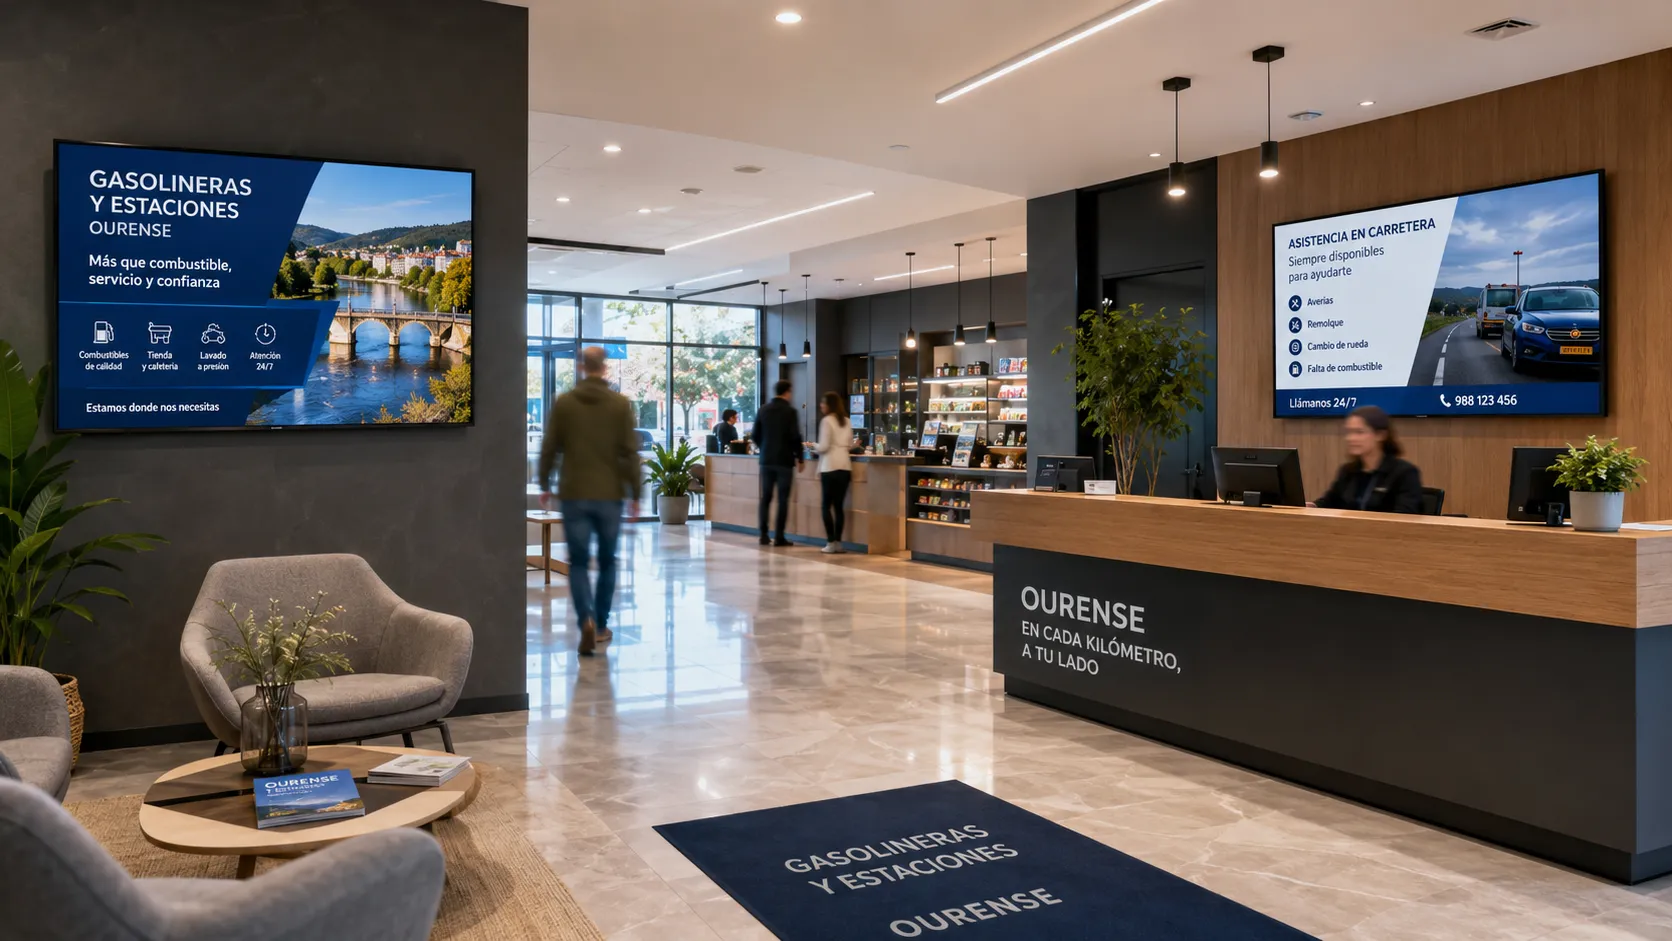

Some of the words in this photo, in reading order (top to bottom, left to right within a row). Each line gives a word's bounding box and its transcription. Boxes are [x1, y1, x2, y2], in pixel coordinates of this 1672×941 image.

[89, 169, 252, 196] GASOLINERAS
[89, 195, 105, 213] Y
[111, 196, 239, 219] ESTACIONES
[89, 220, 172, 238] OURENSE
[1288, 231, 1348, 249] ASISTENCIA
[1351, 228, 1366, 241] EN
[1368, 217, 1436, 237] CARRETERA
[89, 254, 117, 268] Más
[120, 258, 146, 270] que
[149, 257, 232, 273] combustible,
[1288, 254, 1326, 267] Siempre
[1329, 246, 1385, 262] disponibles
[88, 273, 142, 286] servicio
[145, 277, 154, 289] y
[157, 275, 220, 288] confianza
[1288, 271, 1308, 284] para
[1310, 266, 1352, 282] ayudarte
[1307, 319, 1344, 329] Remolque
[1307, 341, 1335, 351] Cambio
[1336, 340, 1346, 350] de
[1346, 340, 1369, 349] rueda
[78, 350, 130, 359] Combustibles
[147, 351, 173, 359] Tienda
[200, 351, 227, 360] Lavado
[85, 362, 95, 371] de
[141, 364, 147, 372] y
[256, 362, 274, 371] 24/7
[1307, 364, 1325, 373] Falta
[1326, 363, 1336, 372] de
[1337, 361, 1383, 372] combustible
[86, 402, 127, 413] Estamos
[129, 402, 158, 412] donde
[160, 404, 177, 412] nos
[178, 402, 220, 412] necesitas
[1289, 397, 1332, 409] Llámanos
[1333, 397, 1357, 408] 24/7
[1455, 395, 1474, 406] 988
[1476, 395, 1495, 406] 123
[1497, 394, 1517, 406] 456
[1021, 585, 1145, 634] OURENSE
[1022, 620, 1039, 638] EN
[1043, 625, 1082, 648] CADA
[1086, 636, 1181, 674] KILÓMETRO,
[1022, 643, 1032, 659] A
[1035, 645, 1054, 664] TU
[1058, 651, 1099, 675] LADO
[264, 774, 339, 789] OURENSE
[784, 824, 989, 874] GASOLINERAS
[808, 878, 836, 895] Y
[836, 843, 1019, 890] ESTACIONES
[889, 887, 1063, 939] OURENSE
